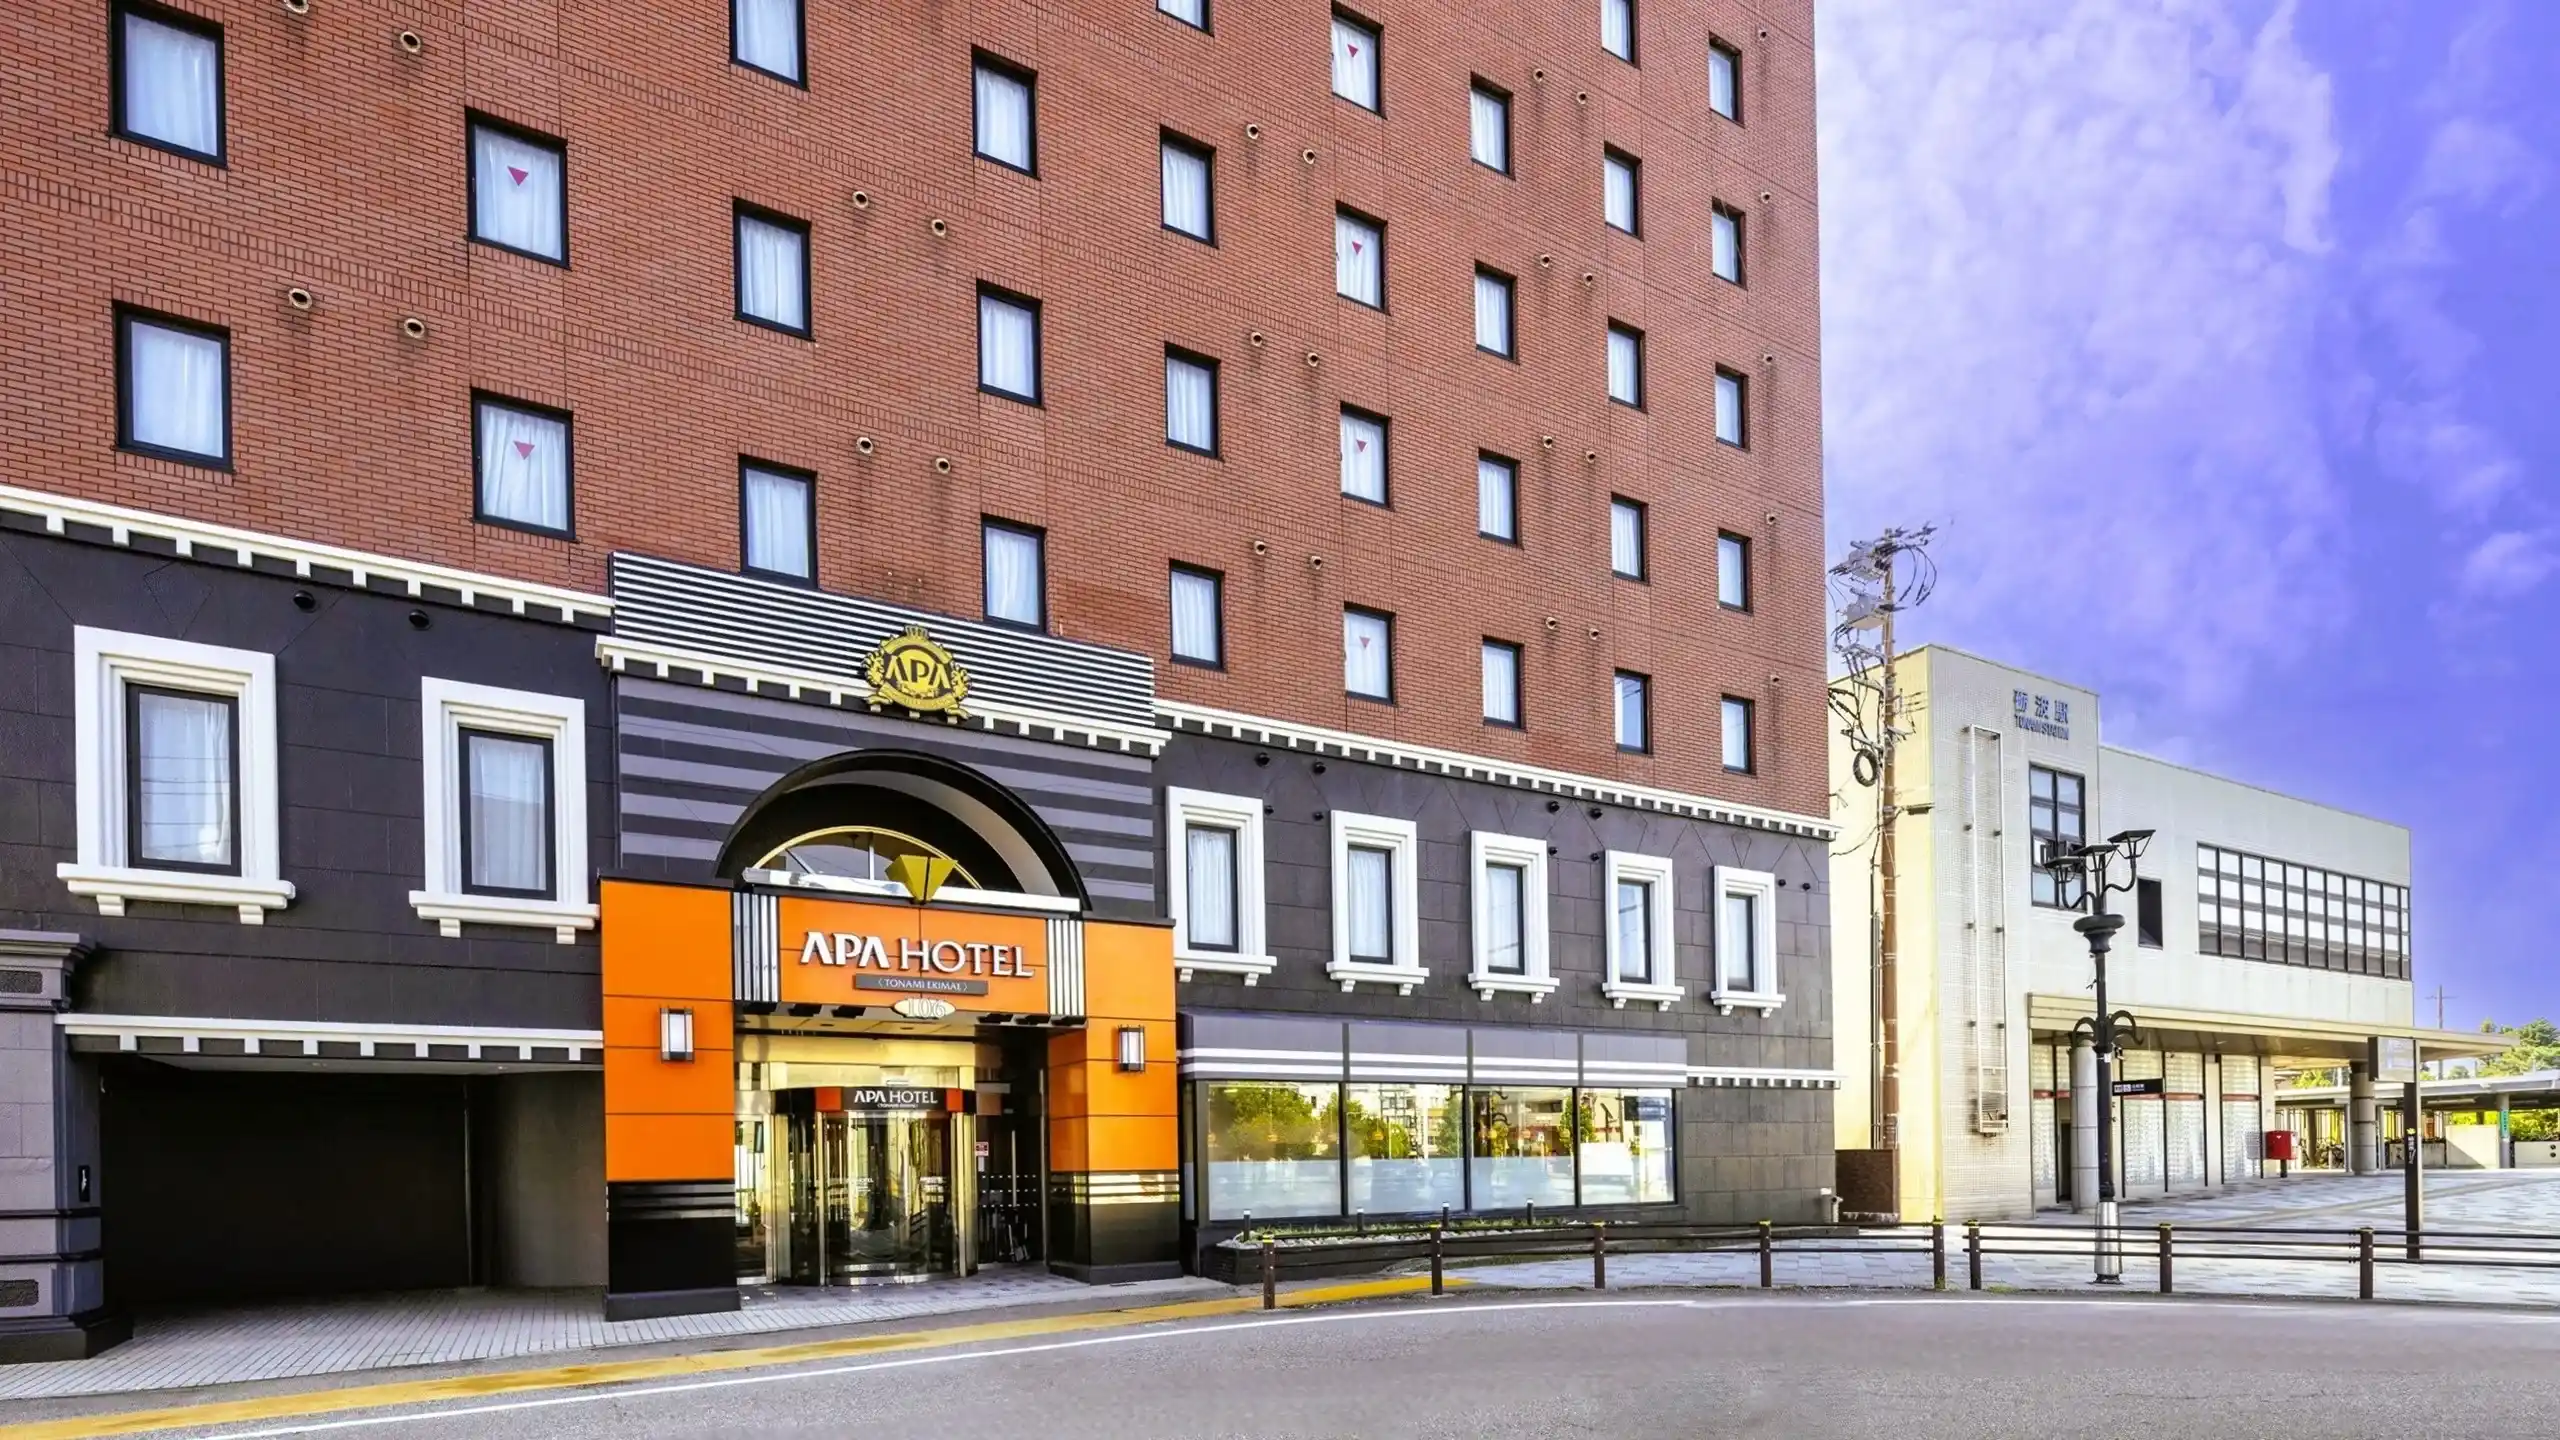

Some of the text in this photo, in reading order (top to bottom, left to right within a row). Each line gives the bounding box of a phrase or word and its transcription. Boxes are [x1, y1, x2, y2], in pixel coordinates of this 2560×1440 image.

[885, 655, 953, 689] APA
[801, 931, 1035, 978] APA HOTEL
[854, 1090, 939, 1104] APA HOTEL
